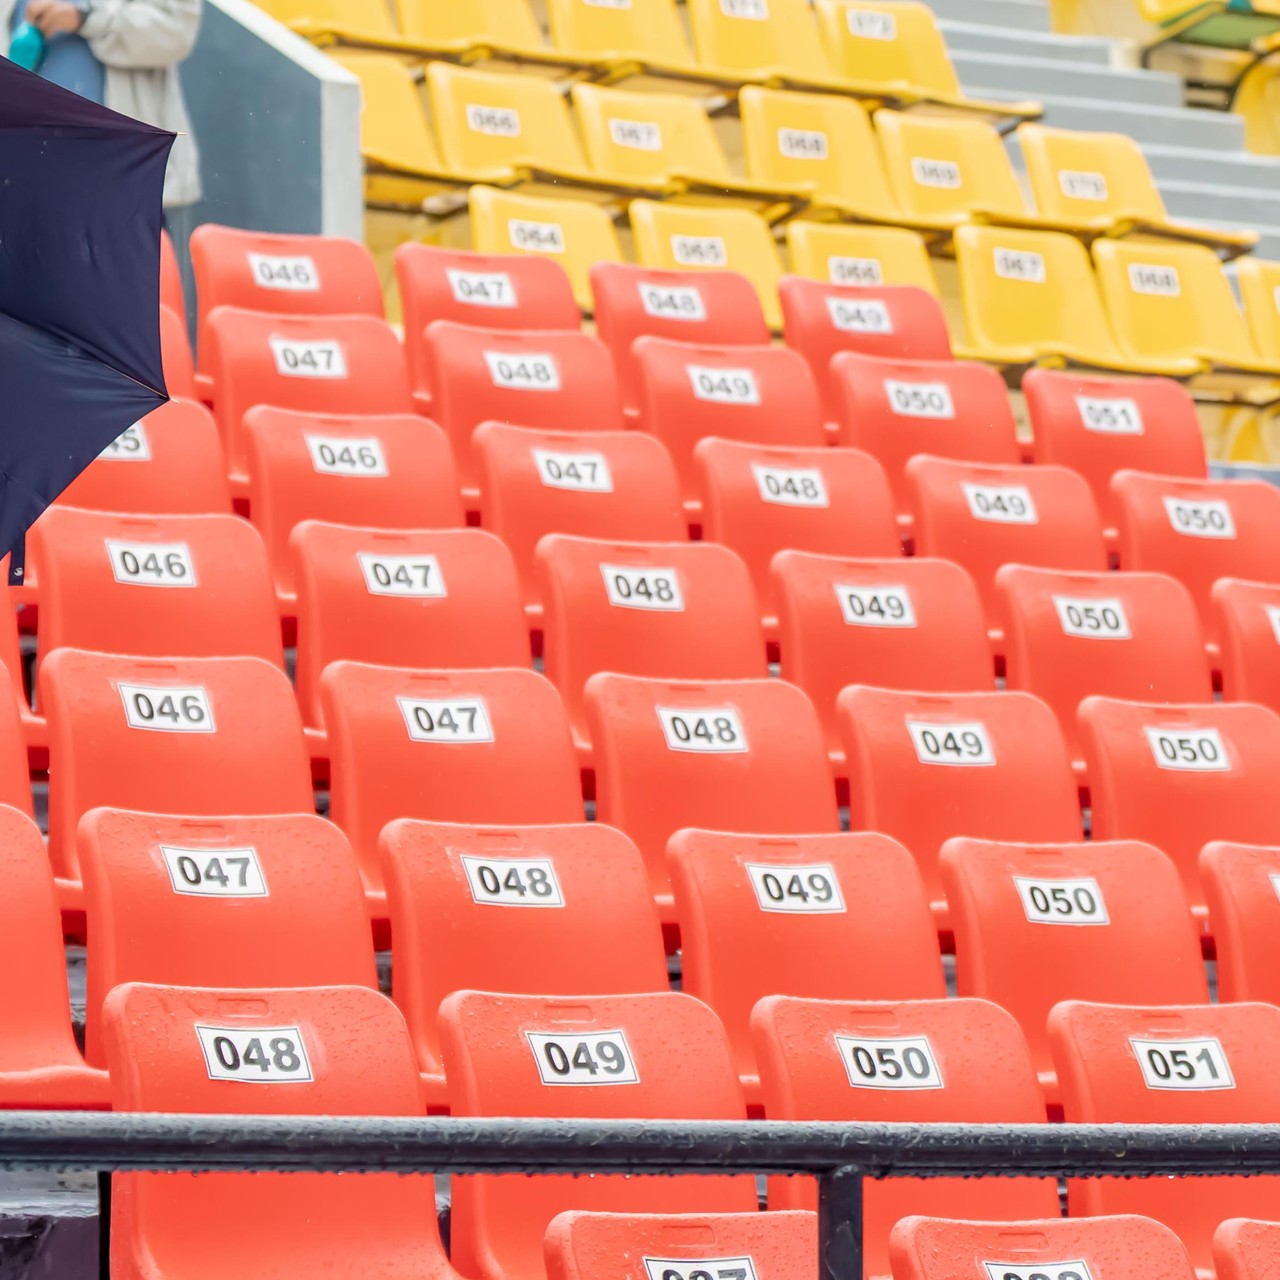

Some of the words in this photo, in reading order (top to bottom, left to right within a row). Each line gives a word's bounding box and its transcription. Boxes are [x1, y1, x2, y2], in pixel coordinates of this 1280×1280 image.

[260, 262, 310, 283] 046
[459, 279, 503, 299] 047
[283, 348, 333, 369] 047
[498, 362, 551, 382] 048
[699, 374, 750, 397] 049
[896, 389, 944, 411] 050
[1087, 405, 1132, 427] 051
[319, 444, 377, 468] 046
[546, 459, 597, 482] 047
[765, 475, 818, 498] 048
[975, 493, 1026, 515] 049
[1176, 506, 1225, 530] 050
[121, 551, 186, 577] 046
[372, 563, 430, 587] 047
[615, 575, 674, 602] 048
[849, 594, 904, 619] 049
[1067, 605, 1120, 630] 050
[134, 693, 204, 722] 046
[414, 707, 476, 733] 047
[671, 717, 736, 743] 048
[922, 731, 983, 756] 049
[1159, 737, 1218, 762] 050
[177, 856, 249, 886] 047
[478, 866, 552, 896] 048
[763, 874, 832, 902] 049
[1030, 886, 1096, 915] 050
[214, 1037, 300, 1071] 048
[544, 1042, 625, 1075] 049
[853, 1047, 929, 1080] 050
[1148, 1049, 1218, 1080] 051
